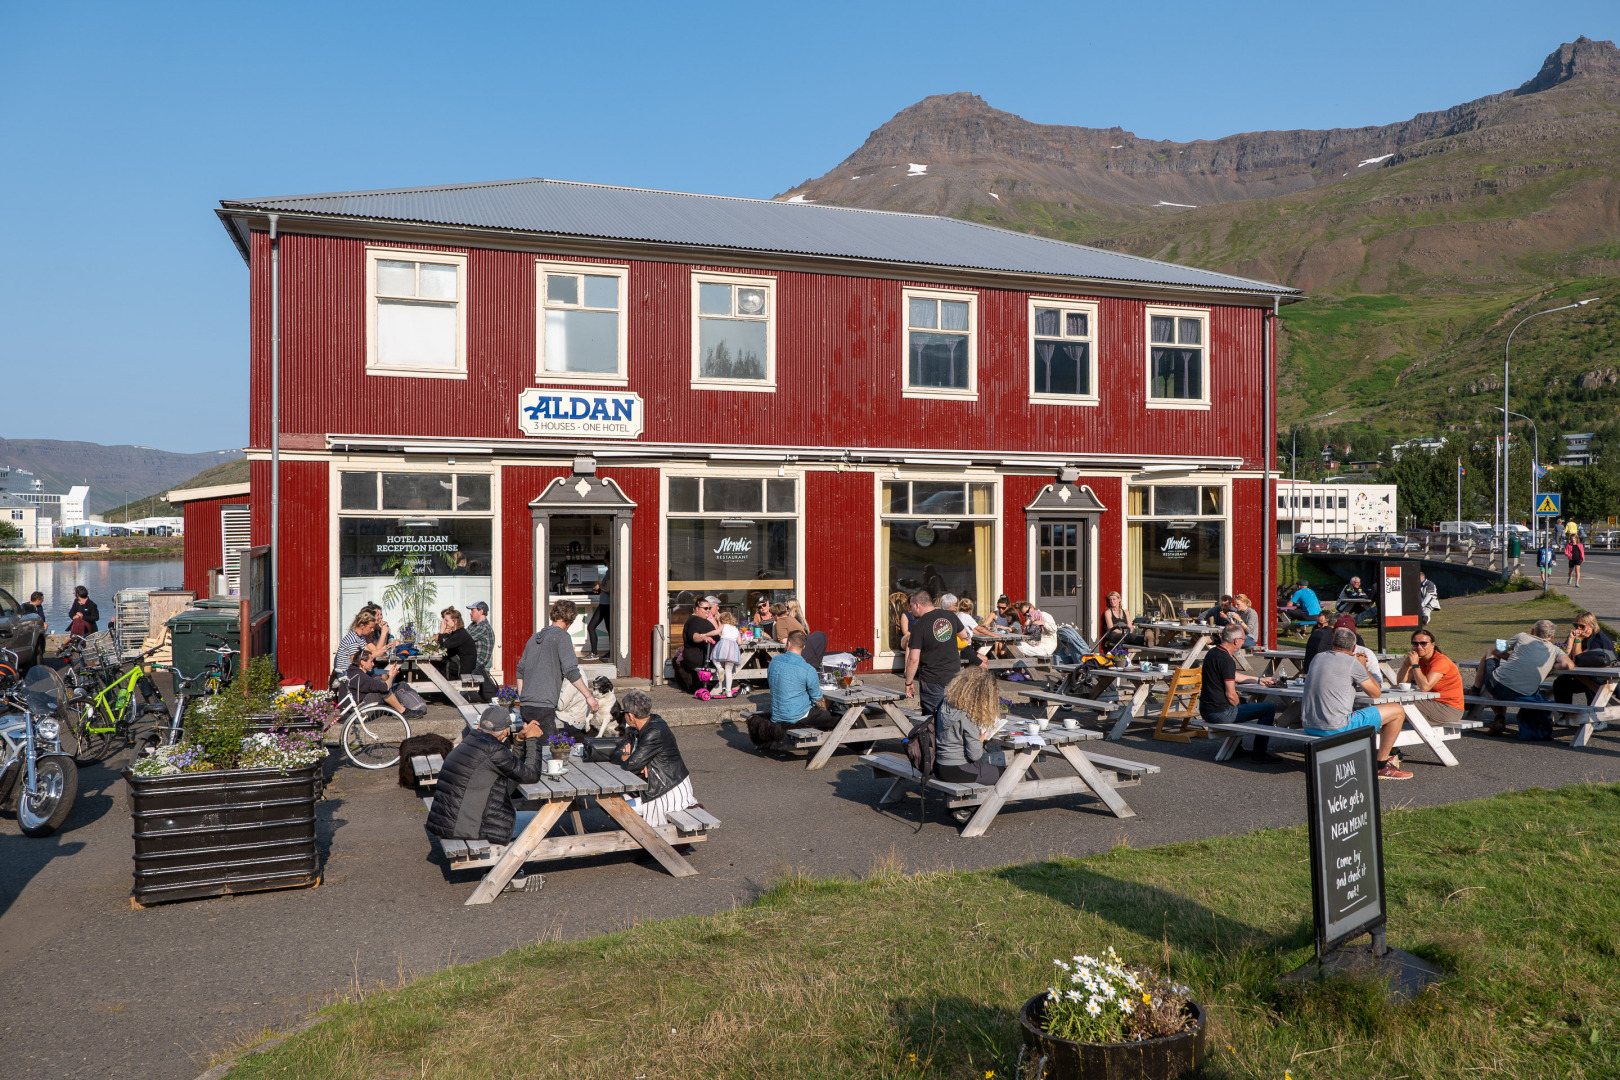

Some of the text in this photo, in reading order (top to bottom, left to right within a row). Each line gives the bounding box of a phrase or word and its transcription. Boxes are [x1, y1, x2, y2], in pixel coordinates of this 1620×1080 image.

[524, 396, 634, 421] ALDAN
[534, 422, 539, 430] 3
[541, 422, 575, 431] HOUSES
[583, 423, 601, 432] ONE
[603, 424, 629, 432] HOTEL
[713, 536, 752, 553] Nordic
[1161, 536, 1190, 551] Nordic
[1335, 760, 1356, 782] ALDAN
[1349, 790, 1359, 813] got
[1331, 821, 1349, 840] NEW
[1353, 850, 1361, 868] by
[1336, 863, 1366, 890] and check it
[1347, 884, 1360, 900] out!
